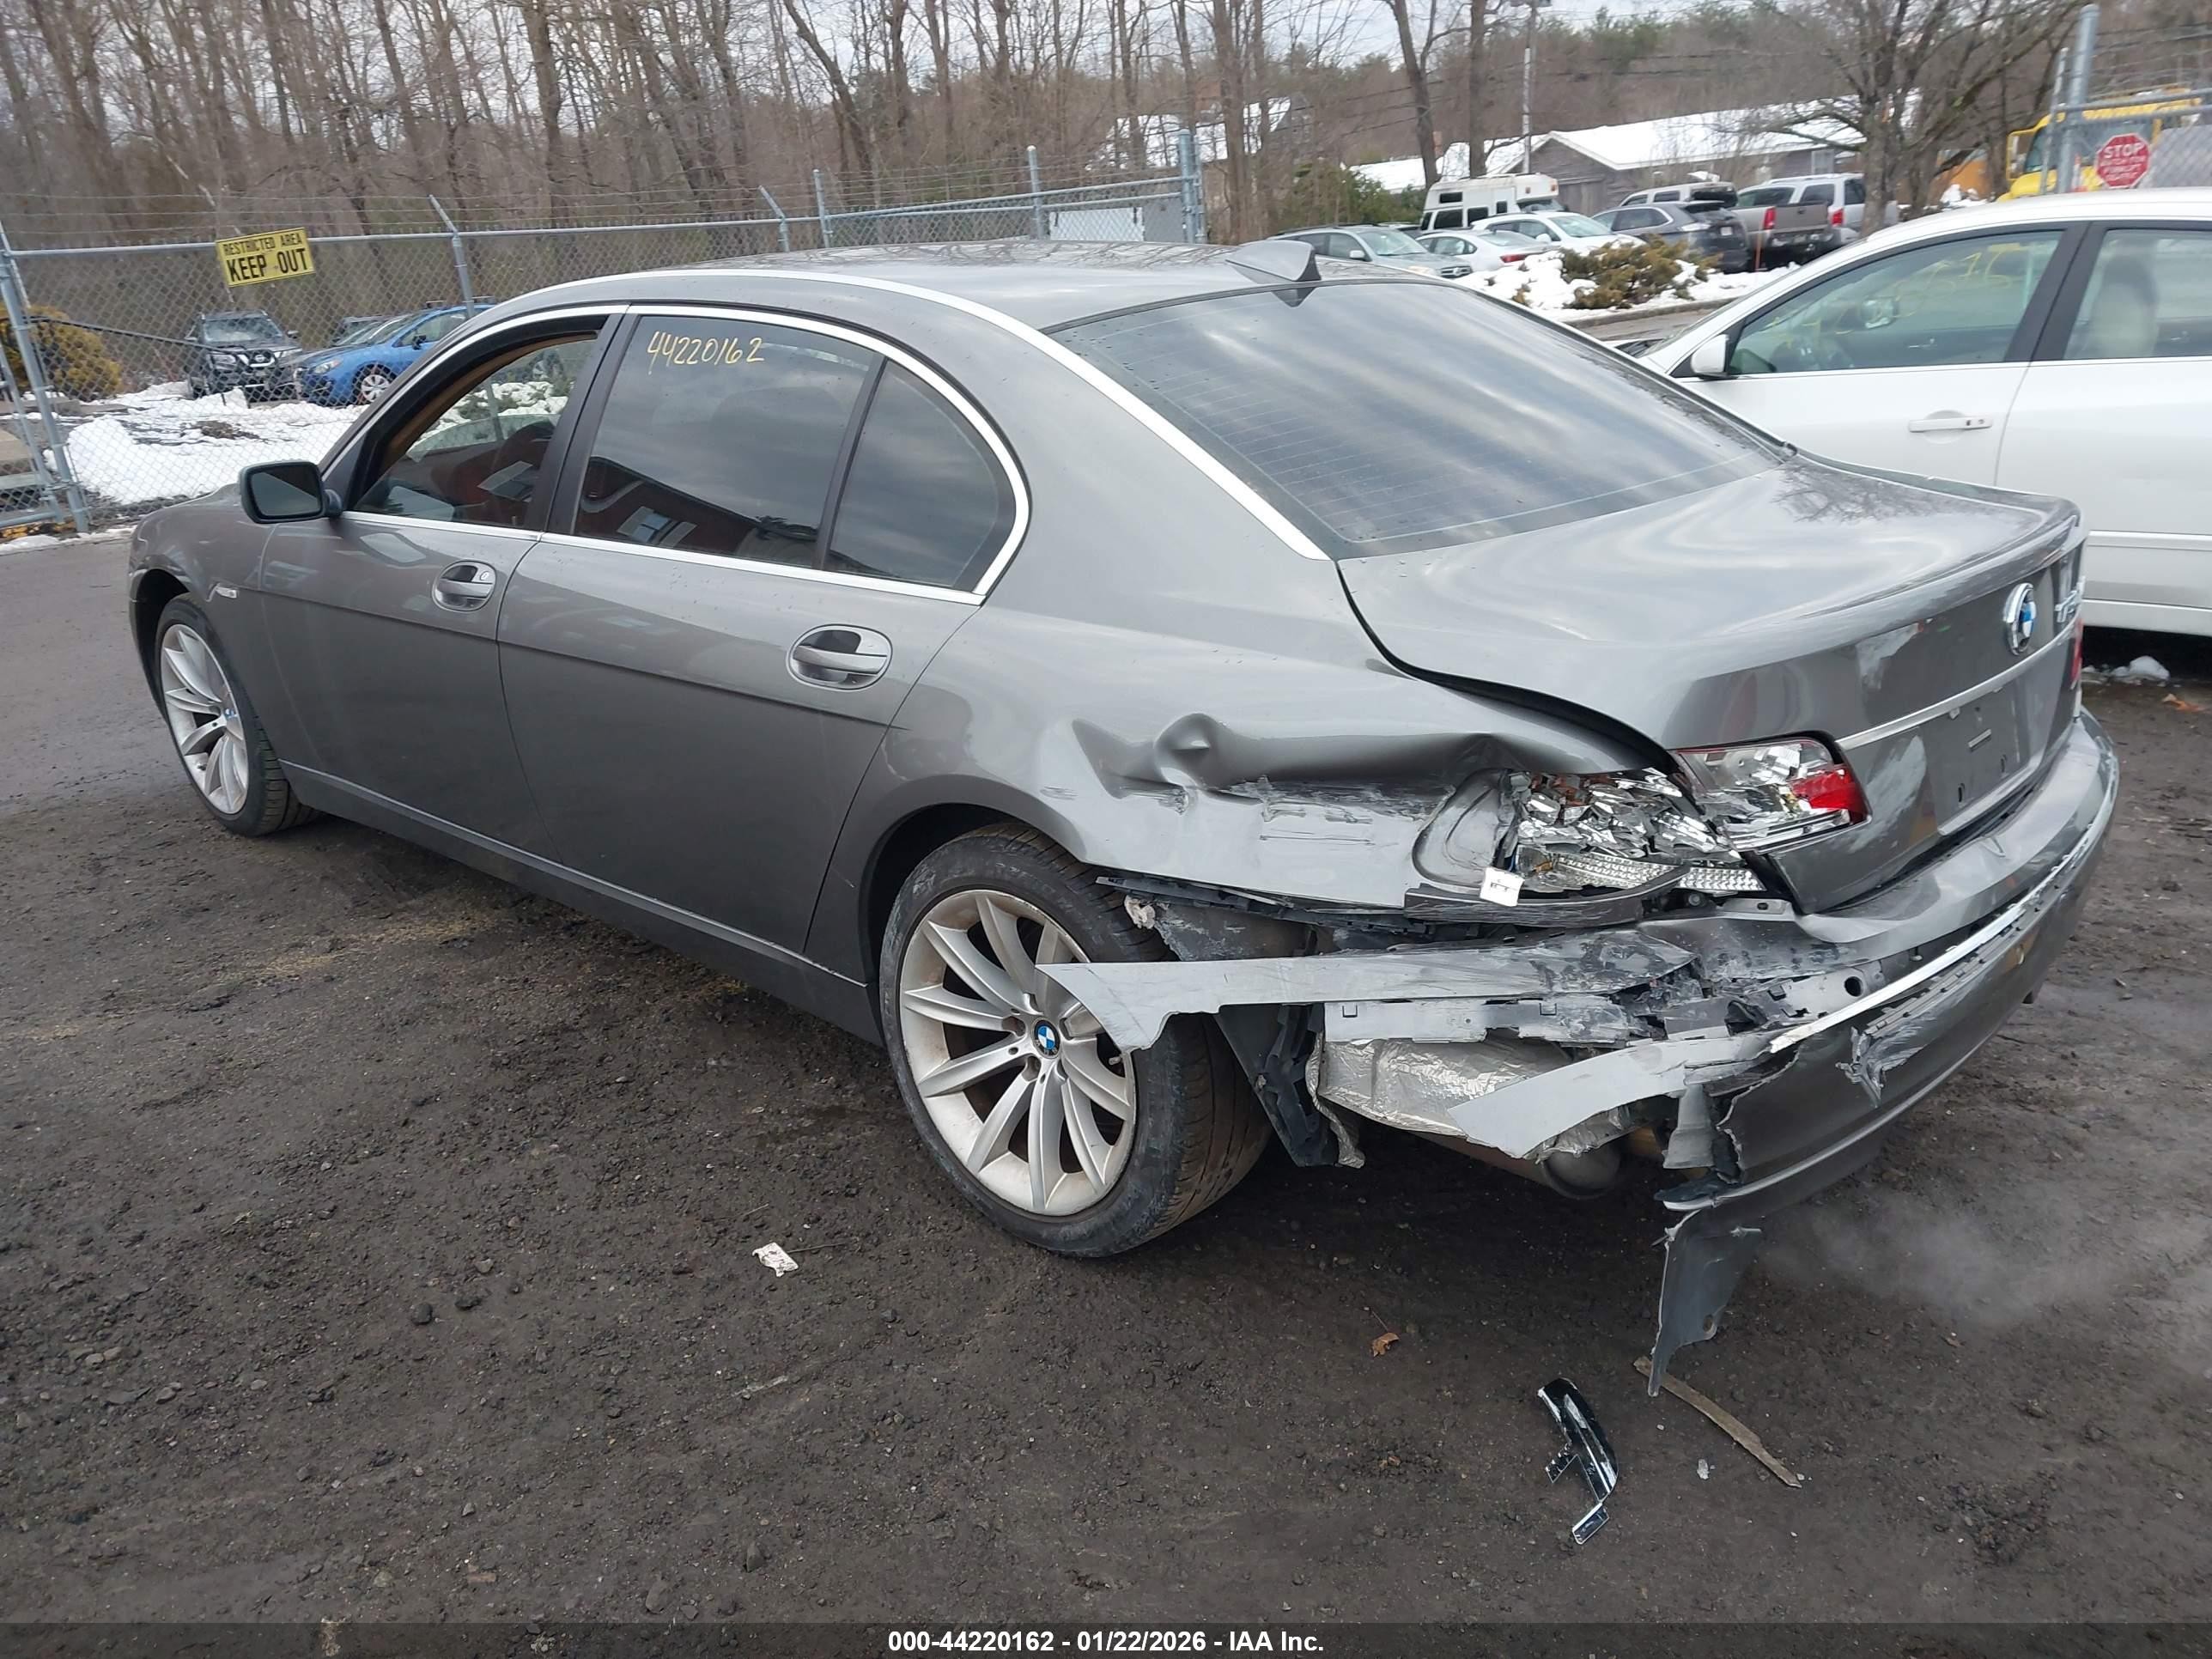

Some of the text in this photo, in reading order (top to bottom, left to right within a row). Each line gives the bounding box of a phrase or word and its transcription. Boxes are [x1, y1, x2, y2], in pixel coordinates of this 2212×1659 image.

[2104, 143, 2145, 159] STOP
[222, 233, 303, 255] RESTRICTED AREA
[226, 248, 308, 283] KEEP OUT
[647, 330, 765, 375] 44220162
